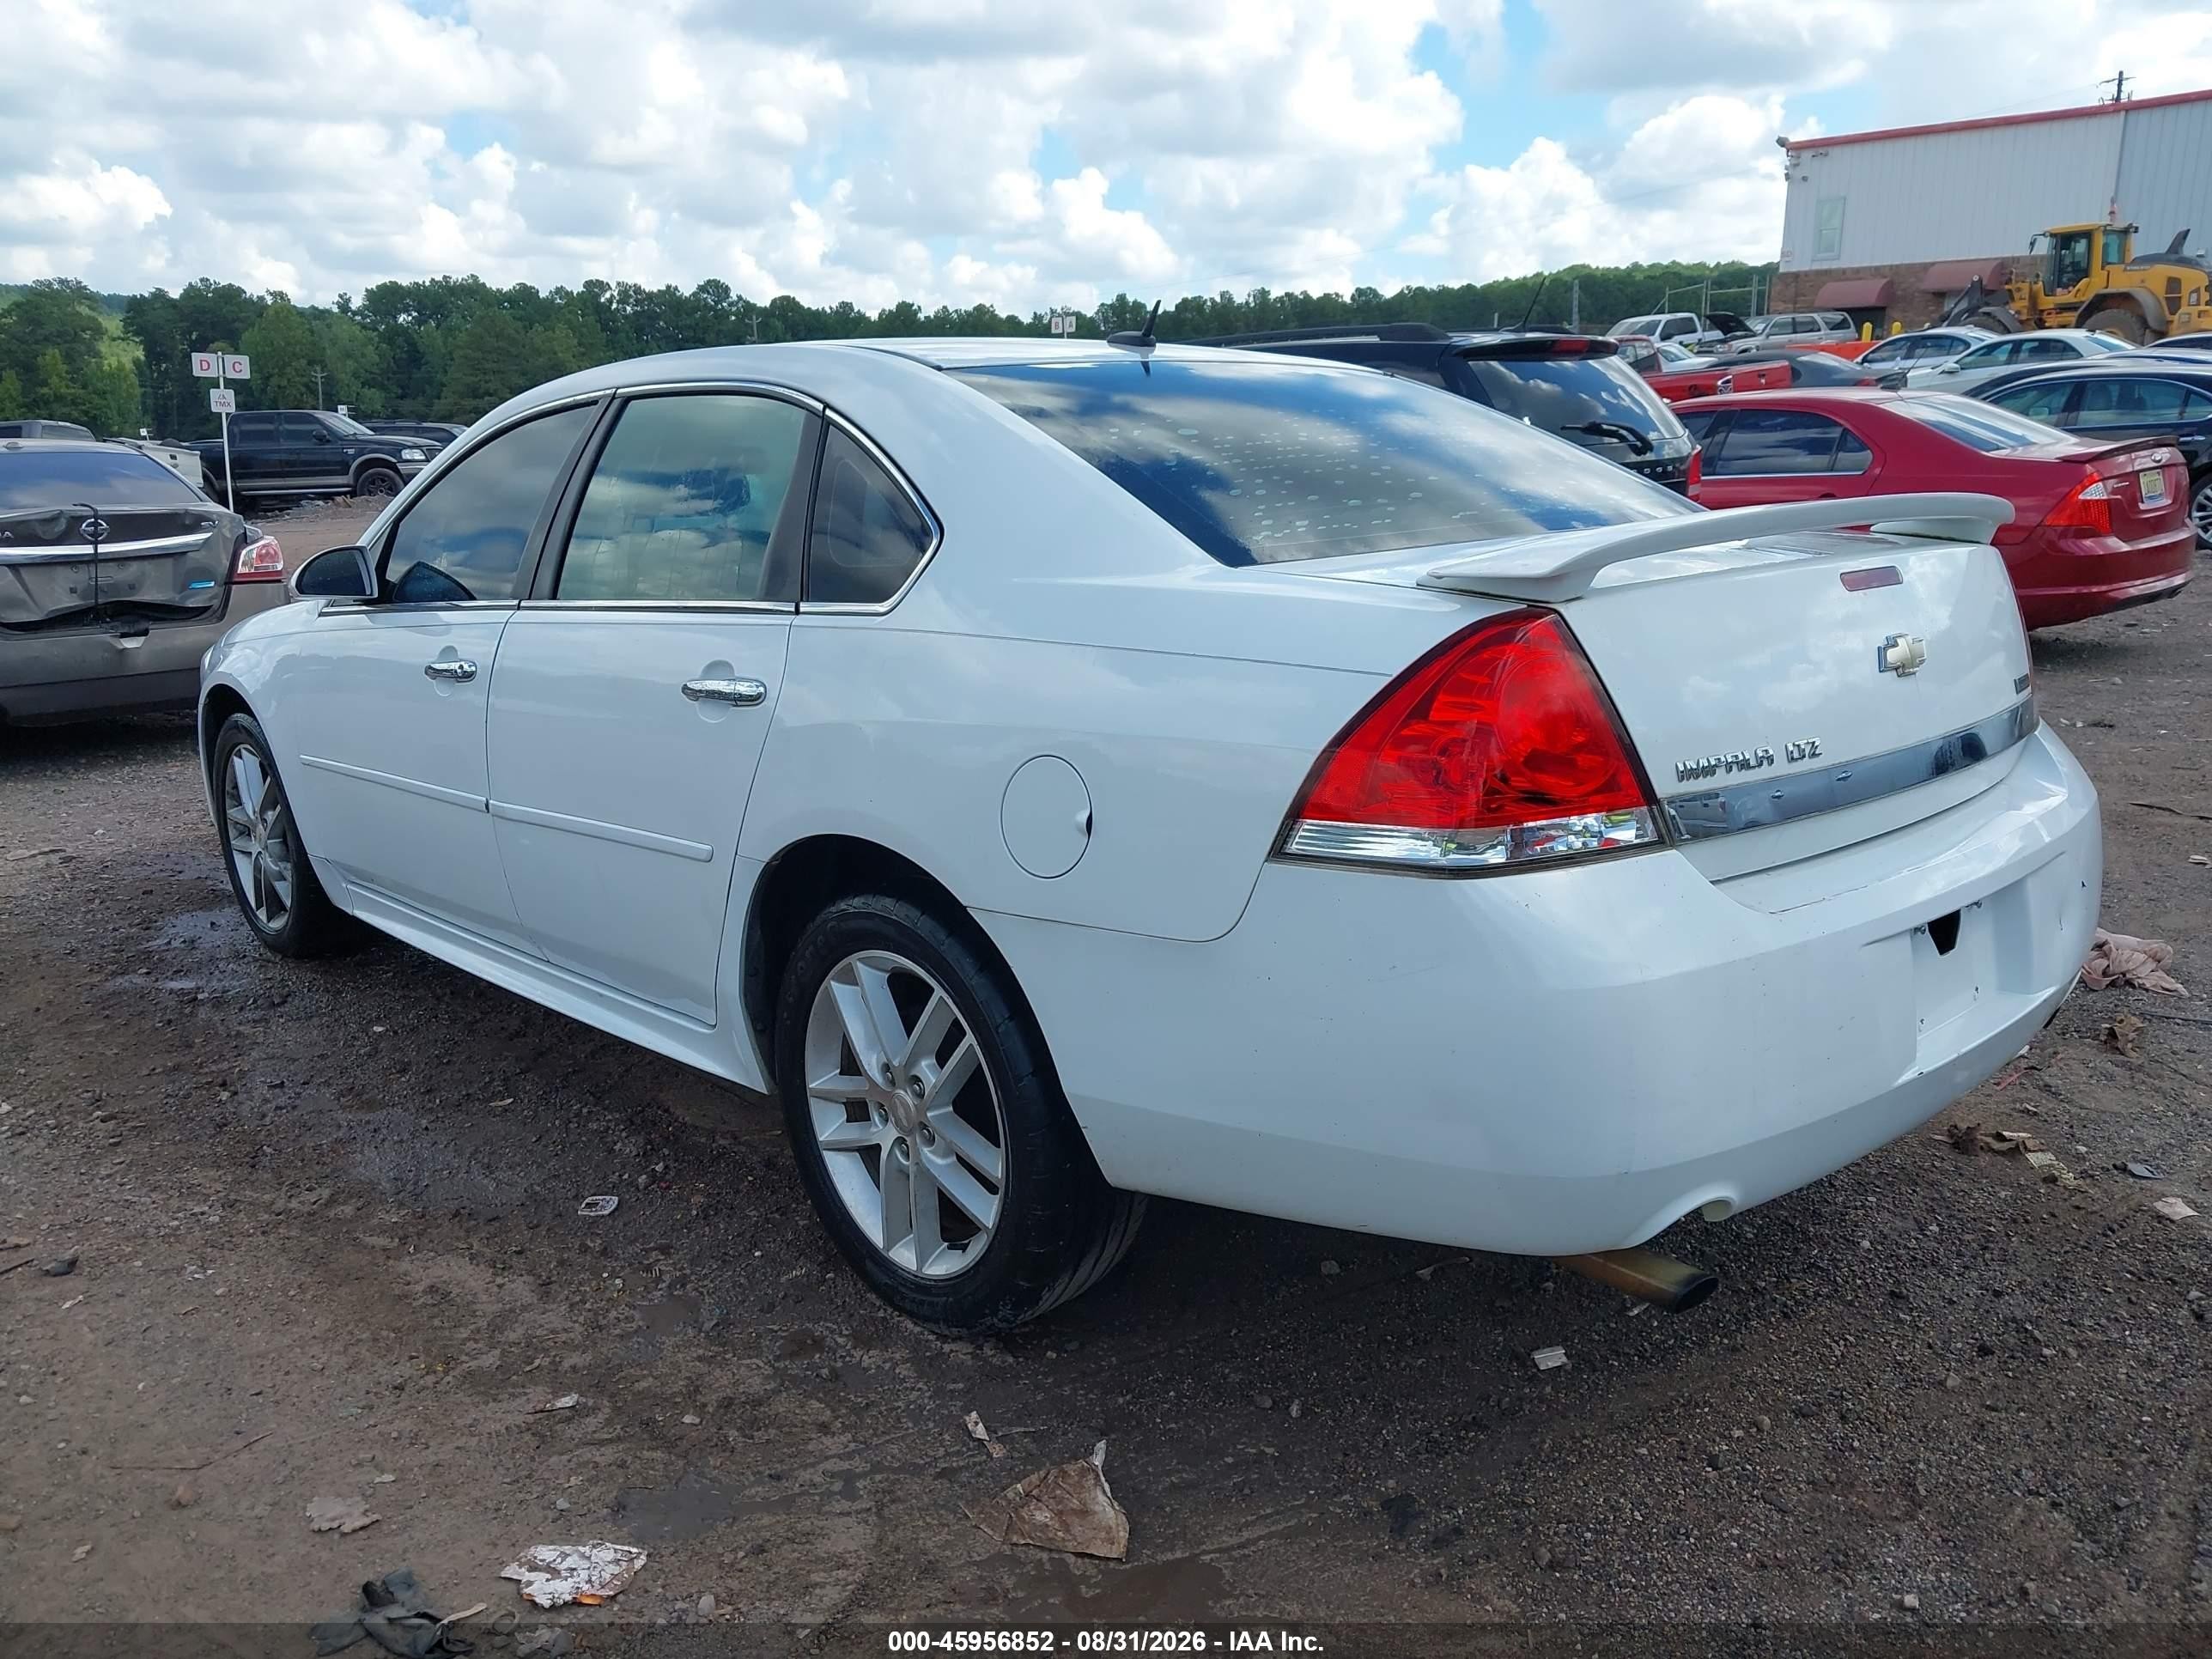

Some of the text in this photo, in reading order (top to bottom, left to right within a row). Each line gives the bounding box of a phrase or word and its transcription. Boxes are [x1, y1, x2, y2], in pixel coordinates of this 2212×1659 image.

[199, 359, 210, 371] D
[232, 361, 243, 374] C
[1675, 737, 1823, 782] IMPALA LTZ
